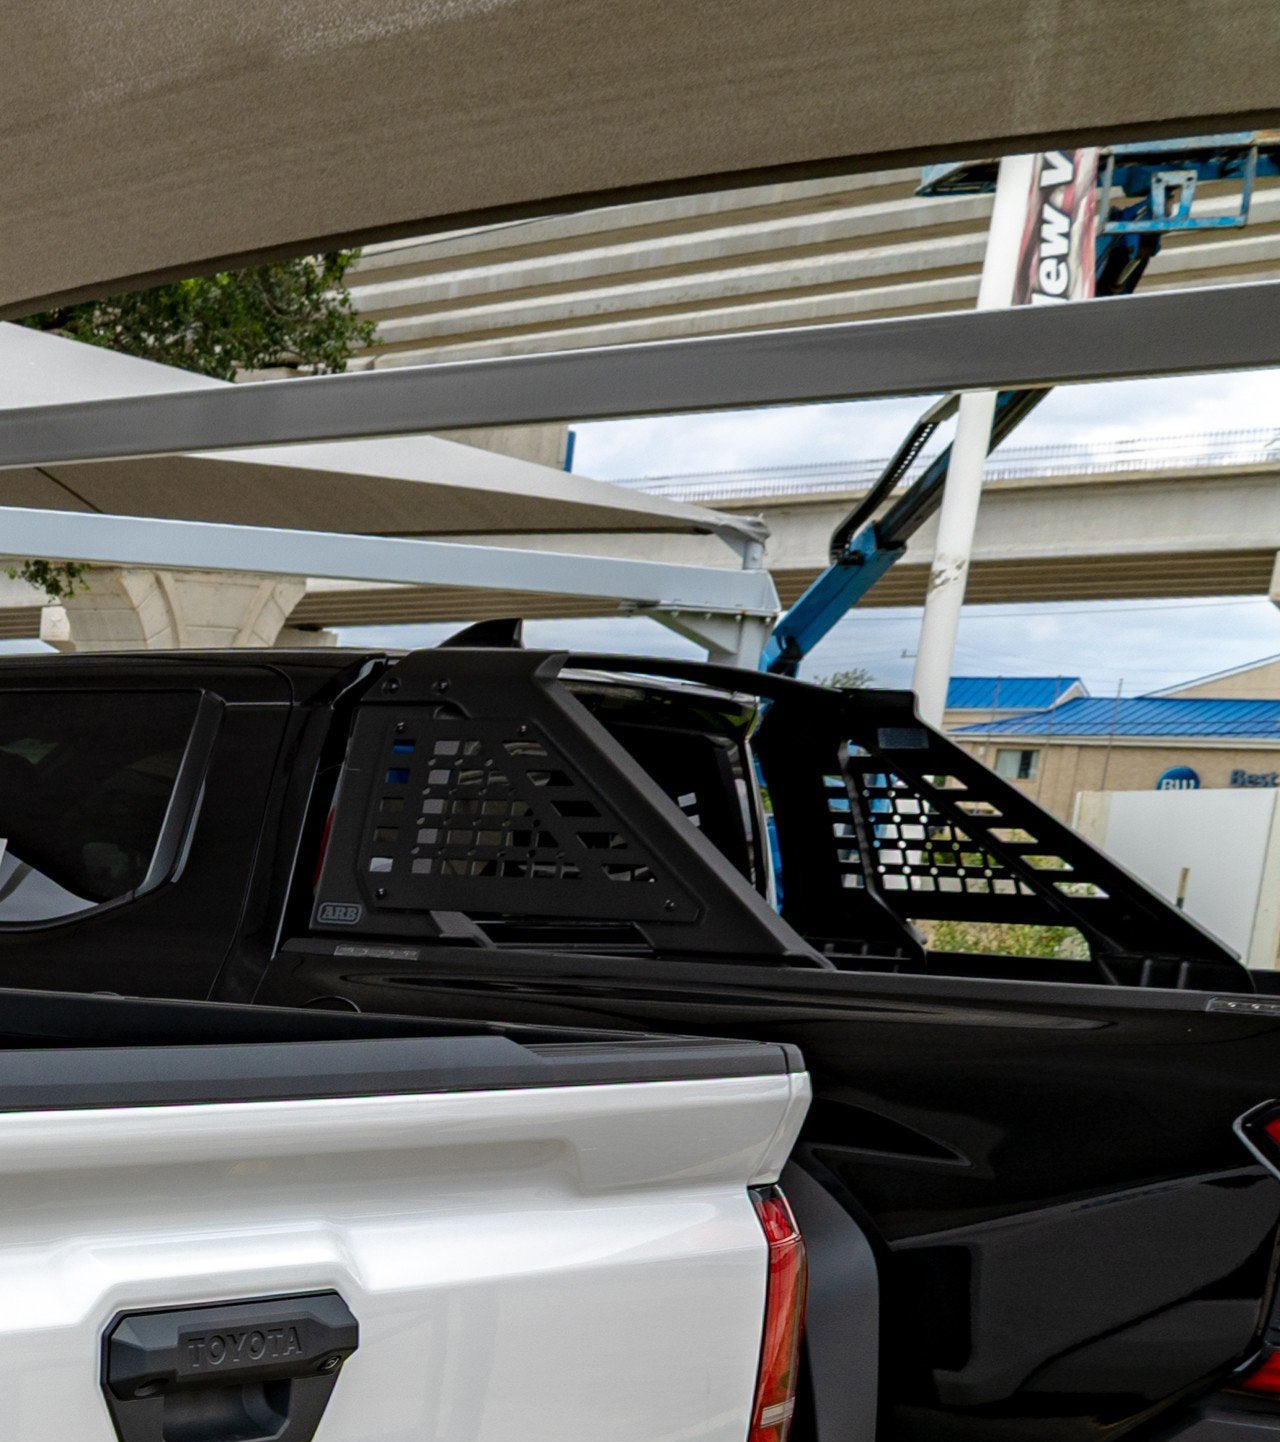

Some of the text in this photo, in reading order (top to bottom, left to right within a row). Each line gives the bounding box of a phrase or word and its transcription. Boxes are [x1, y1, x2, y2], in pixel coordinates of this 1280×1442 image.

[1230, 769, 1279, 788] Best
[322, 906, 358, 920] ARB
[188, 1326, 302, 1367] TOYOTA
